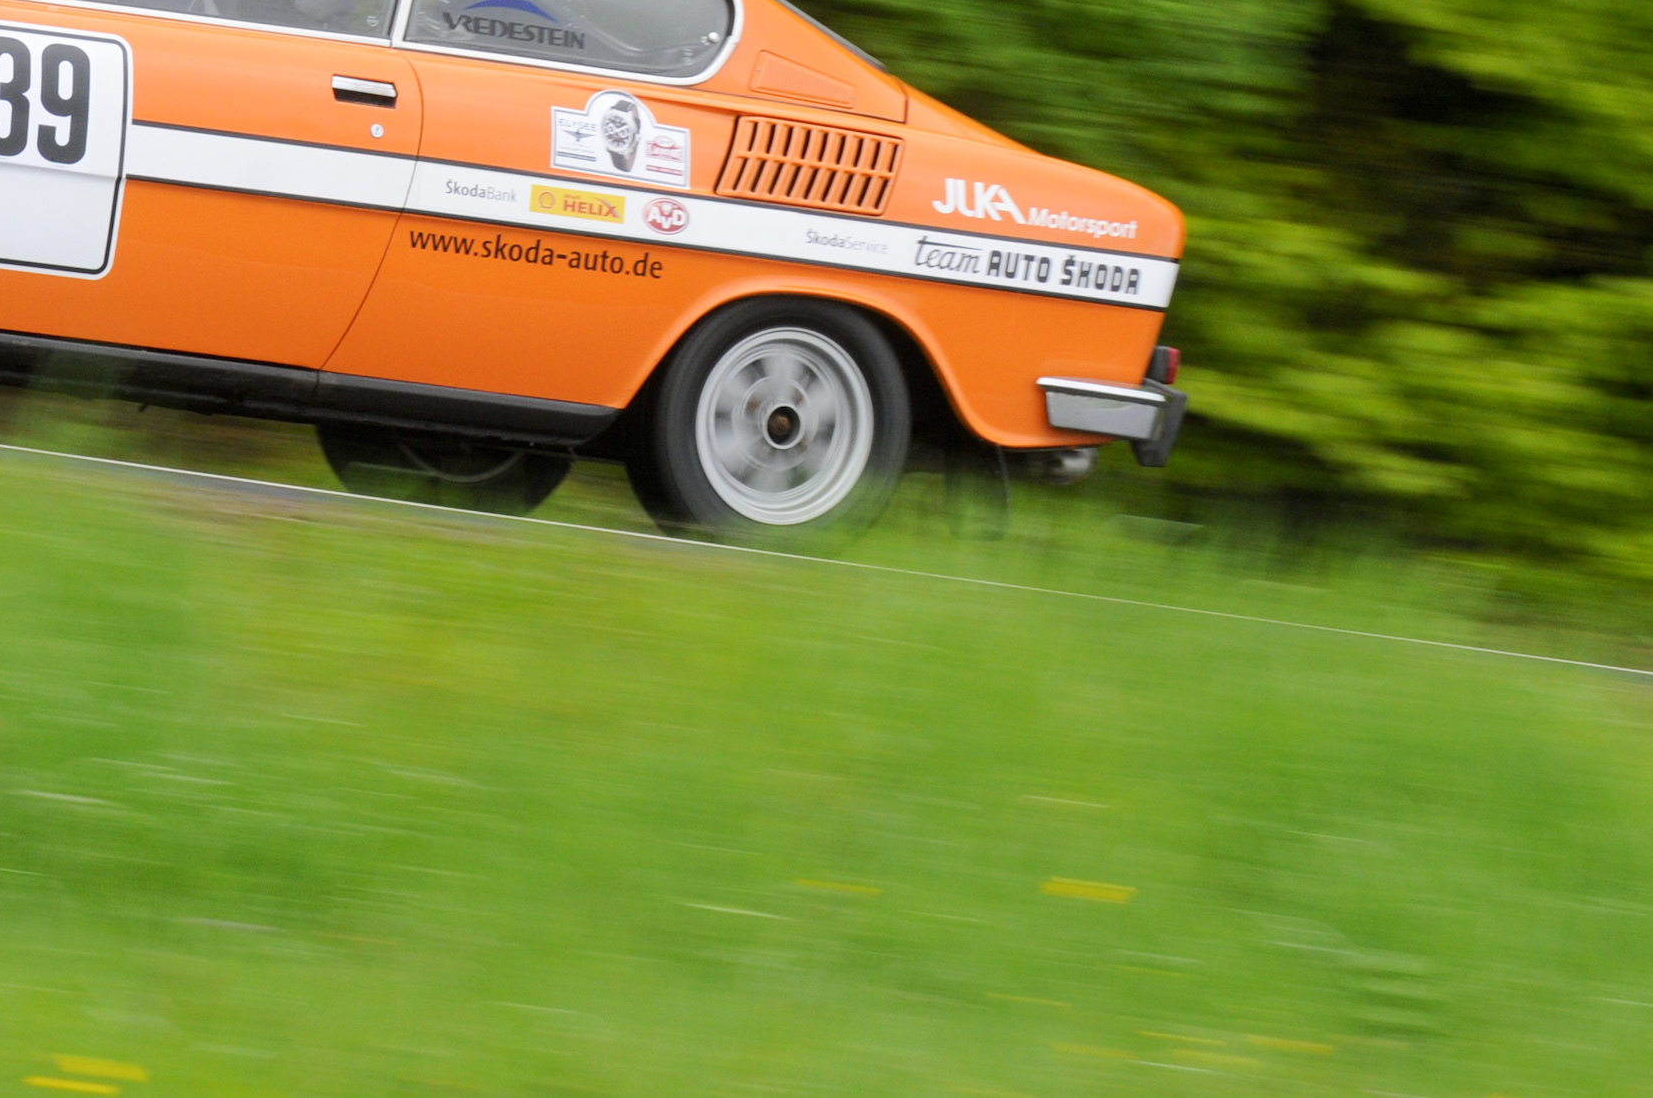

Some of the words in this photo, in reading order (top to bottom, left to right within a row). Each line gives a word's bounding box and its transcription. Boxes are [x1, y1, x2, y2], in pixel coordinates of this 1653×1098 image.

[443, 12, 585, 49] VREDESTEIN
[445, 179, 517, 202] ŠkodaBank
[563, 199, 621, 219] HELIX
[1027, 206, 1139, 238] Motorsport
[409, 229, 663, 279] www.skoda-auto.de
[913, 235, 984, 274] team
[987, 250, 1052, 283] AUTO
[1060, 254, 1141, 295] ŠKODA
